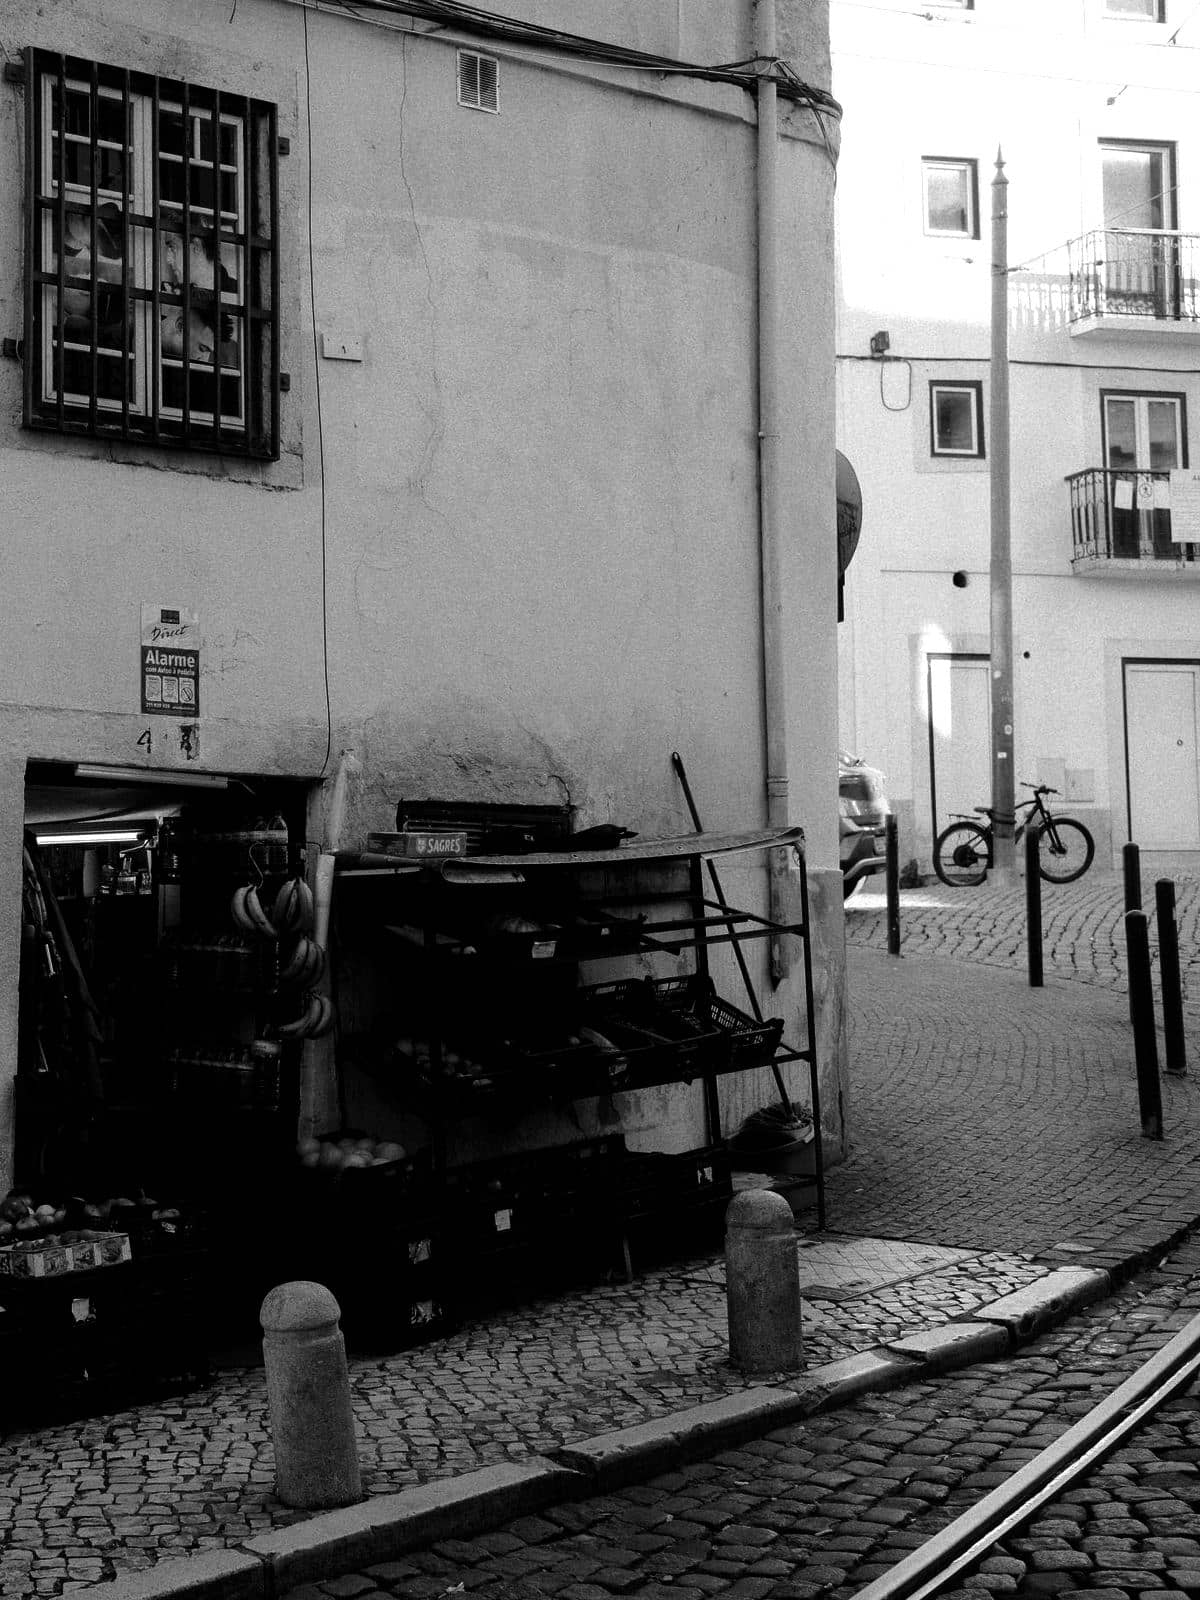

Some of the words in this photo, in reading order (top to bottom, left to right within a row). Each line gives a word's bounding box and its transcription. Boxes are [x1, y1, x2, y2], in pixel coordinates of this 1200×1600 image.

[145, 650, 196, 668] Alarme
[137, 729, 152, 754] 4
[427, 838, 461, 853] SAGRES
